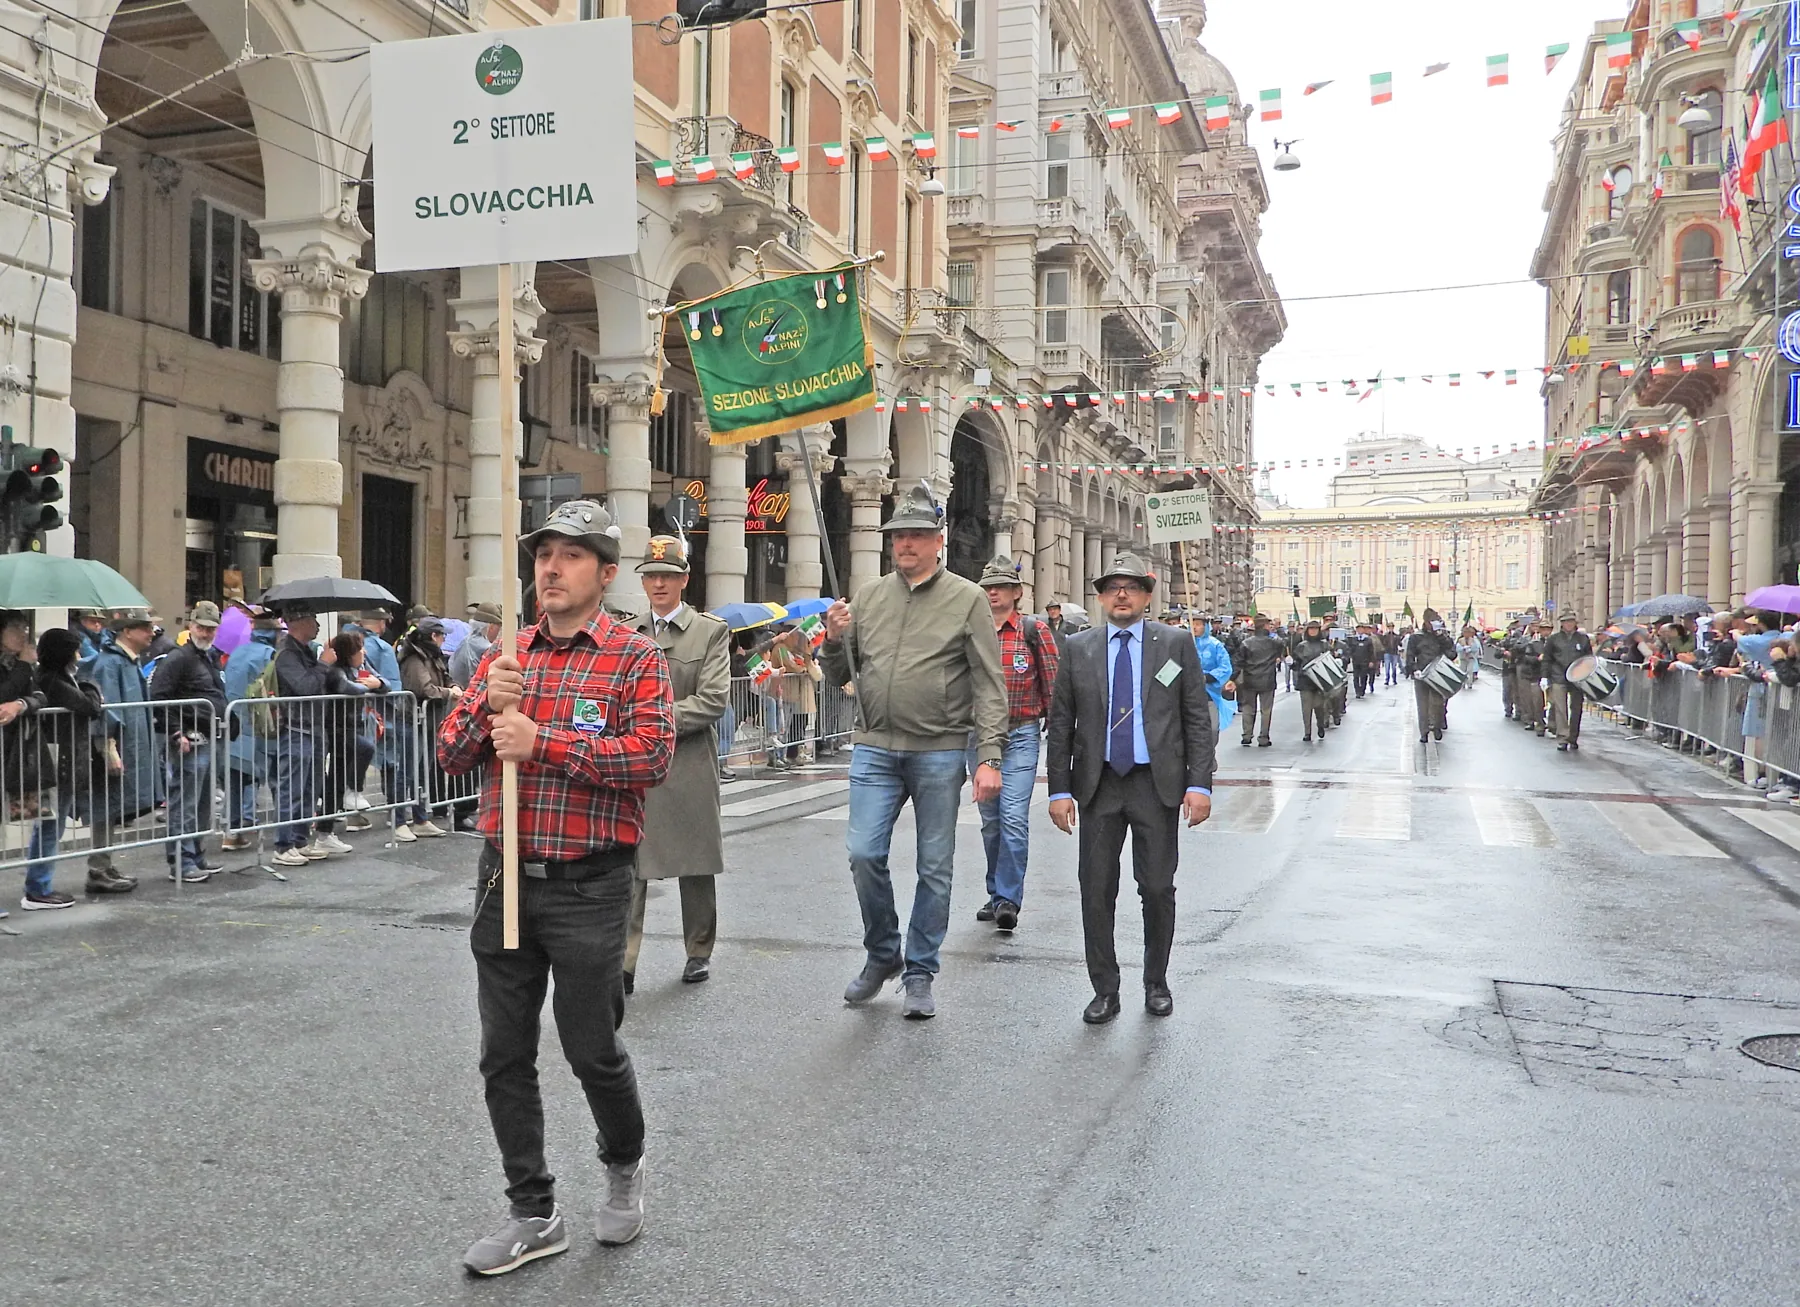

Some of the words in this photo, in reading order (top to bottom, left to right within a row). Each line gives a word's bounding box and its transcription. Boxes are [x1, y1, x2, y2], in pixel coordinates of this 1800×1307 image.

[491, 77, 517, 87] ALPINI
[490, 112, 556, 140] SETTORE
[415, 182, 594, 219] SLOVACCHIA
[768, 340, 800, 354] ALPINI
[712, 385, 774, 412] SEZIONE
[774, 361, 864, 401] SLOVACCHIA
[1171, 493, 1206, 506] SETTORE
[745, 520, 766, 530] 1903
[1156, 511, 1203, 529] SVIZZERA
